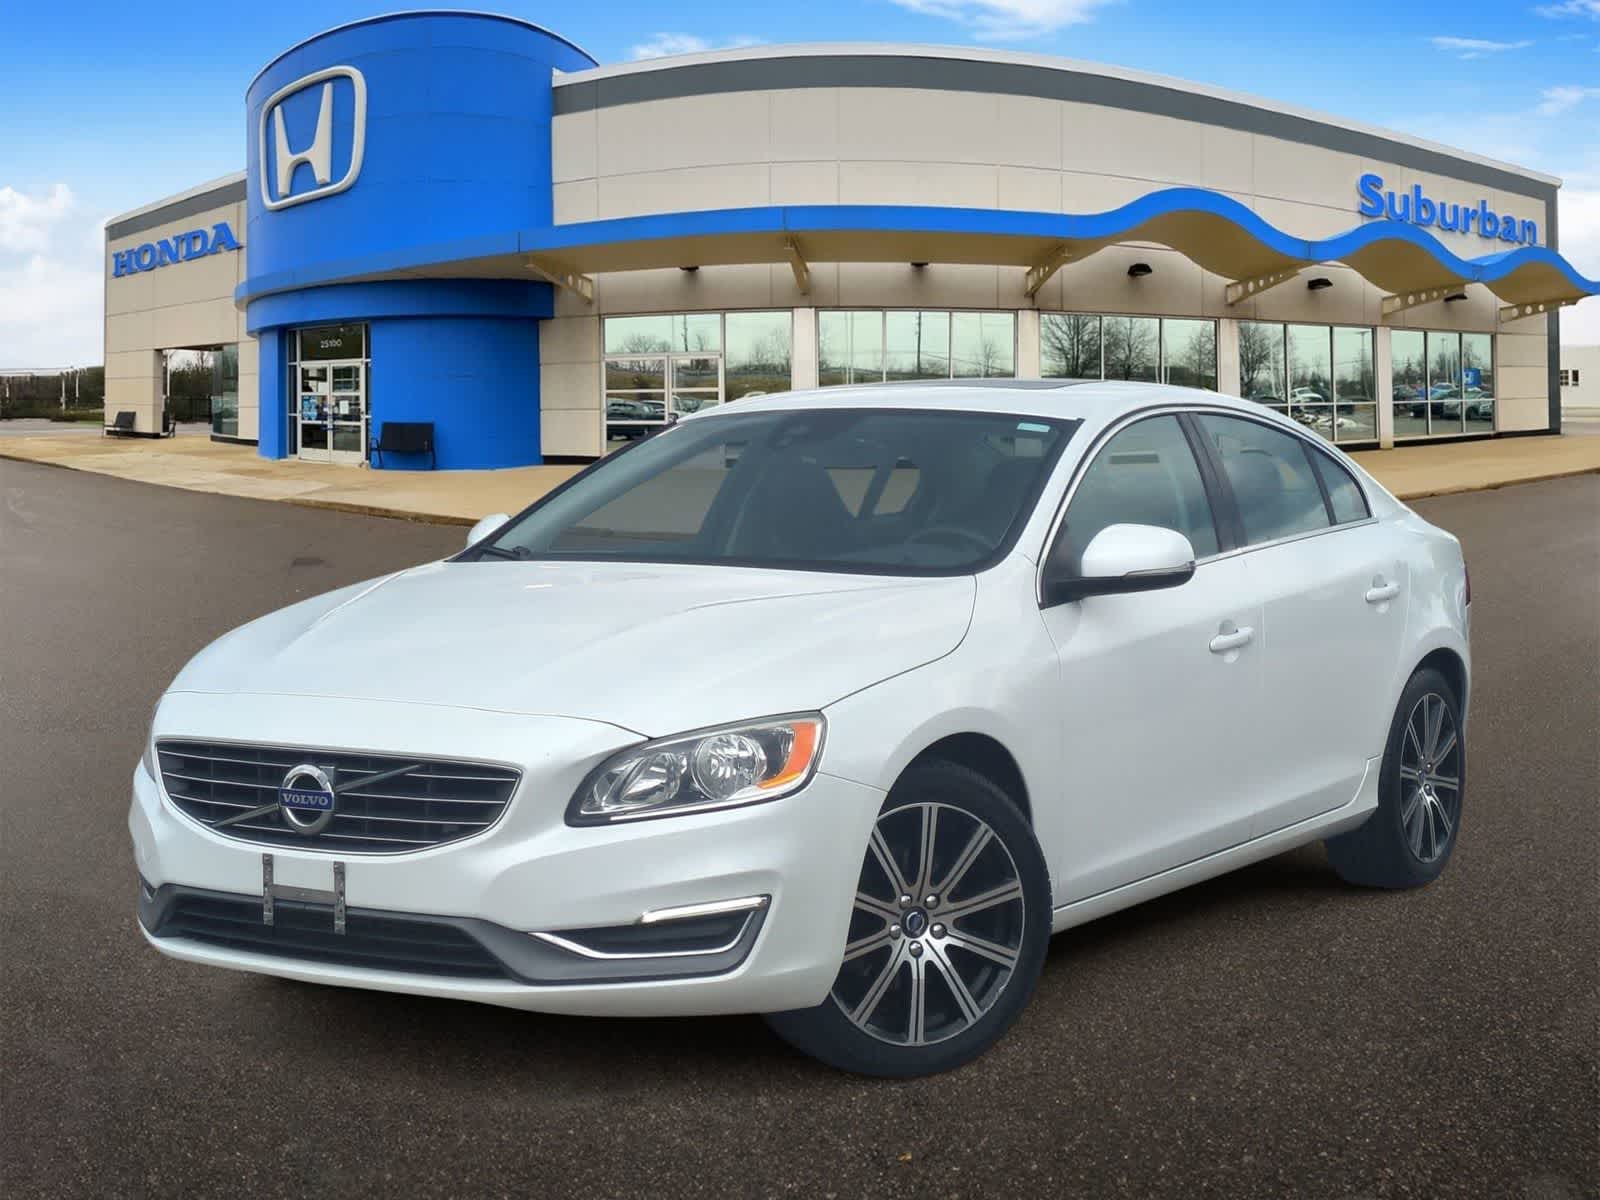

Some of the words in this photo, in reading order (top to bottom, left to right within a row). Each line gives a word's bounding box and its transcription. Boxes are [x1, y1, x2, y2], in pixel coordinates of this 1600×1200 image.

[1357, 173, 1539, 245] Suburban
[112, 221, 241, 278] HONDA
[282, 792, 329, 806] VOLVO
